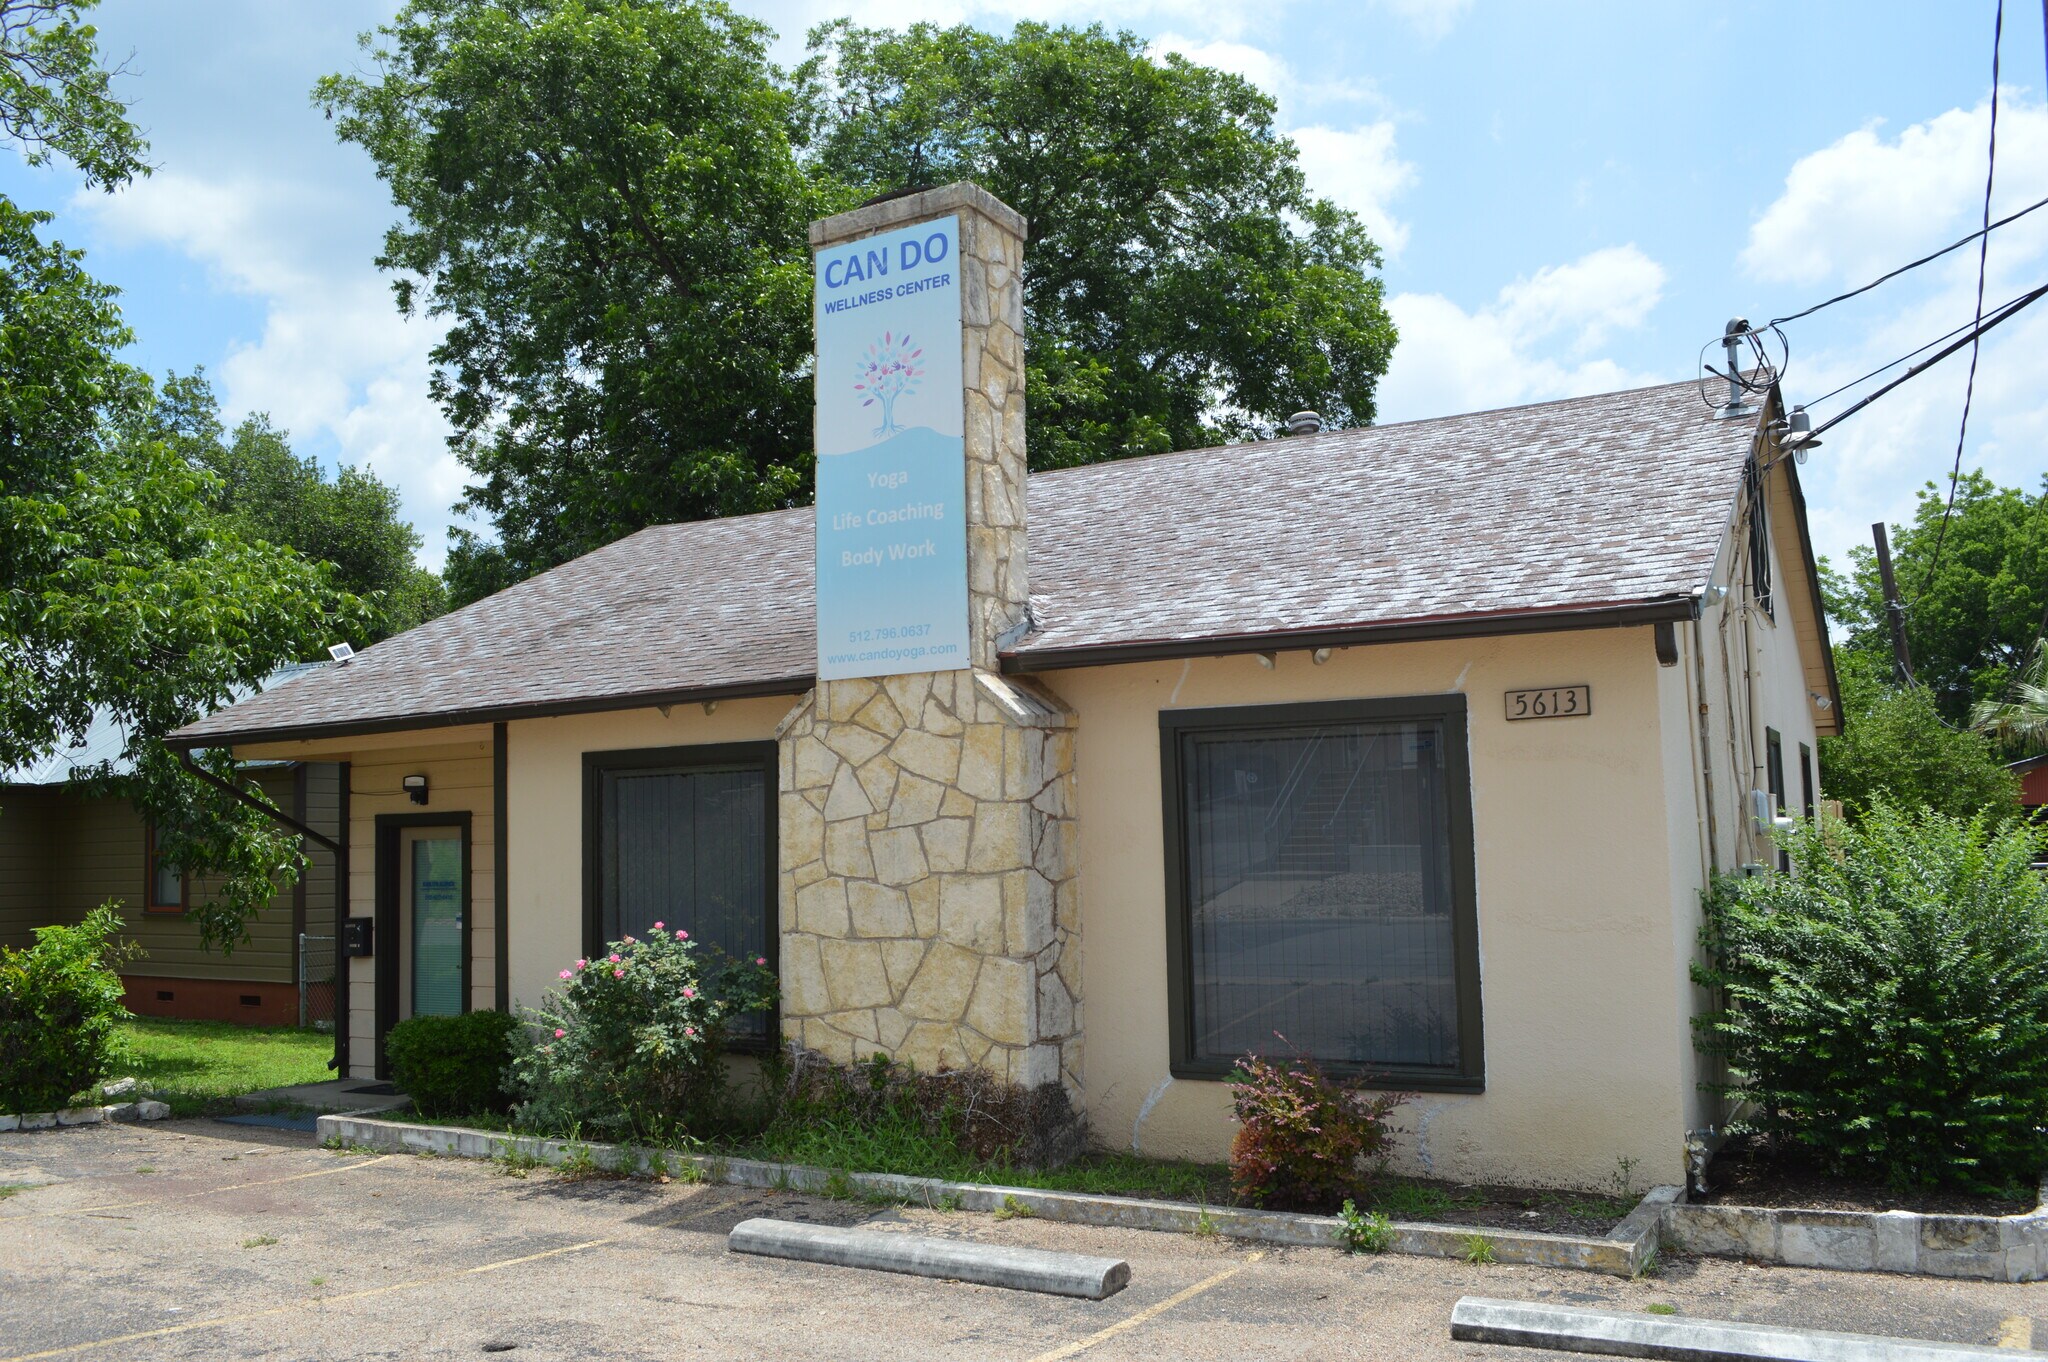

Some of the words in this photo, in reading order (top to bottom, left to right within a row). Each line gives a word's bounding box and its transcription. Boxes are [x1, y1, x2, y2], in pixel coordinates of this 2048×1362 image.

[825, 247, 888, 289] CAN
[900, 232, 949, 271] DO
[824, 287, 893, 315] WELLNESS
[896, 273, 951, 297] CENTER
[867, 471, 908, 489] Yoga
[833, 511, 862, 531] Life
[866, 502, 945, 526] Coaching
[842, 548, 884, 567] Body
[888, 539, 936, 561] Work
[849, 623, 931, 643] 512.796.0637
[827, 643, 957, 665] www.candoyoga.com
[1515, 690, 1577, 716] 5613
